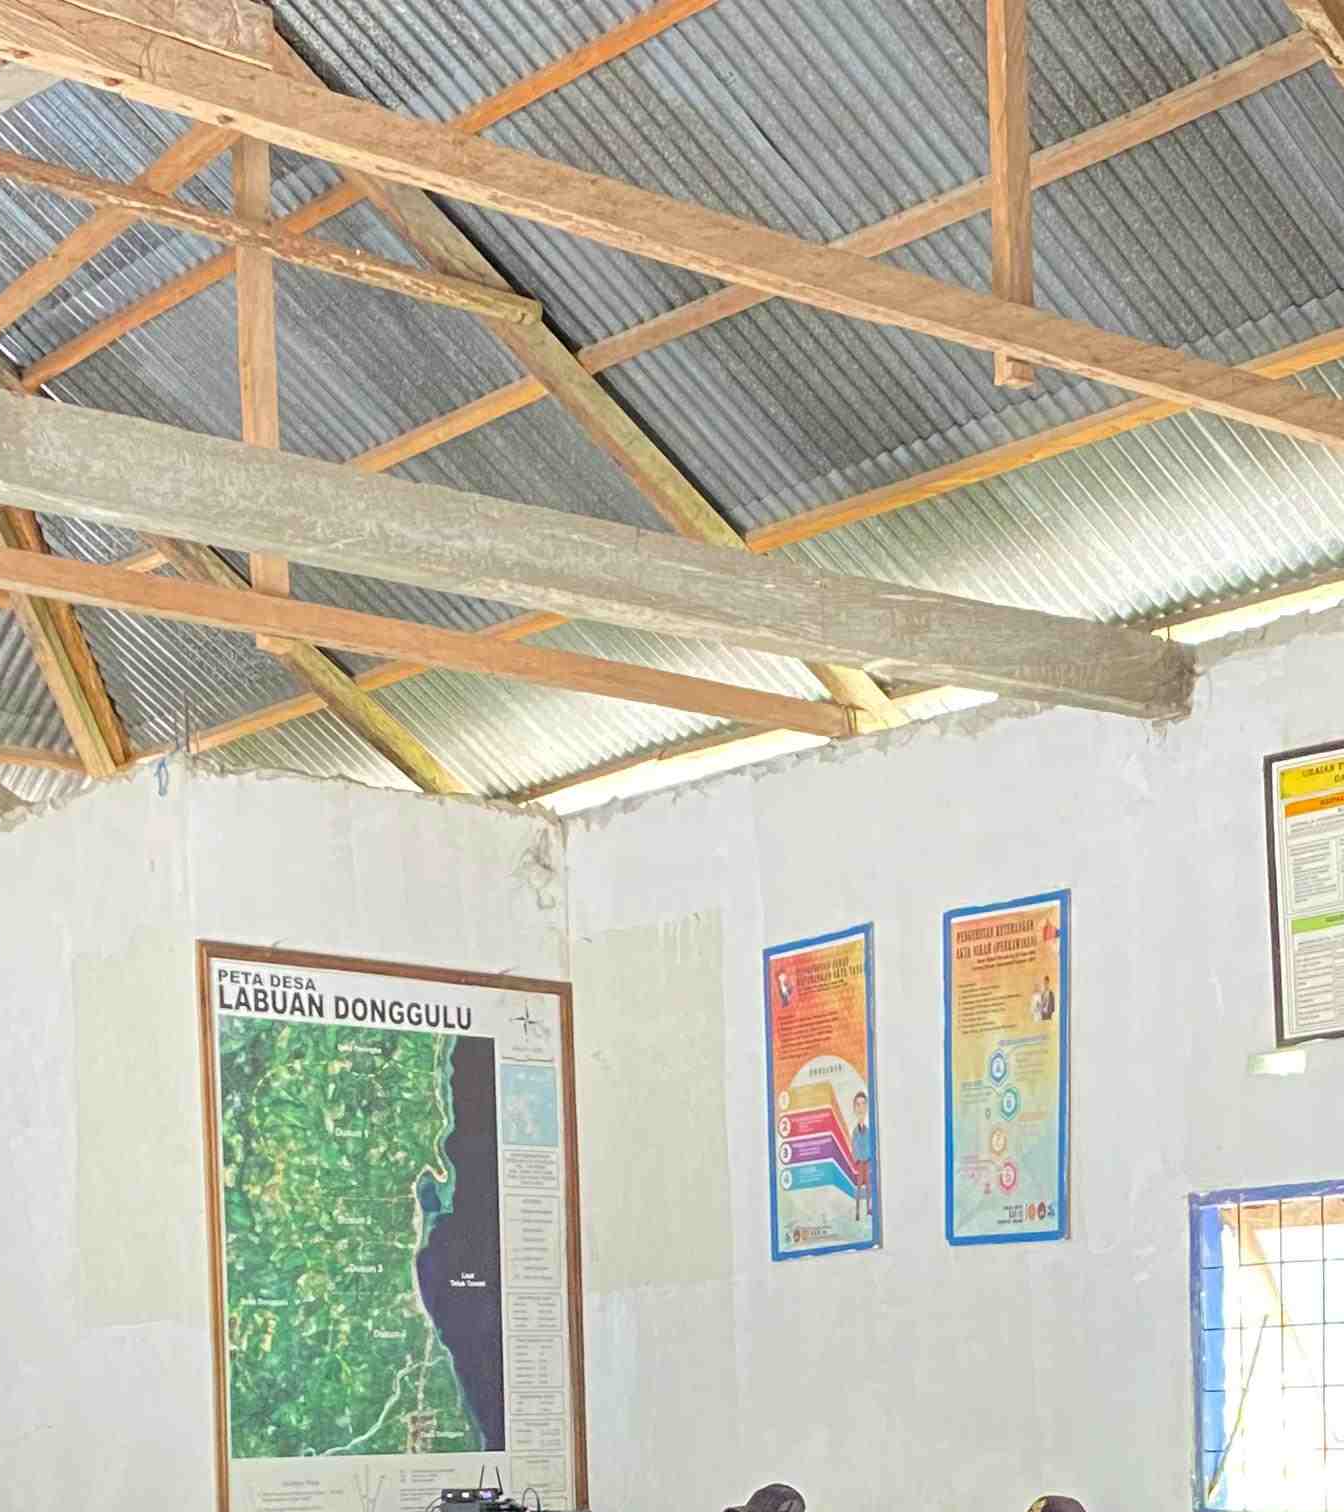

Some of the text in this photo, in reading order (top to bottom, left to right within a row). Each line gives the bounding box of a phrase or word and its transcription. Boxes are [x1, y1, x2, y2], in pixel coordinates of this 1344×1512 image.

[218, 969, 317, 991] PETA DESA
[218, 985, 472, 1031] LABUAN DONGGULU
